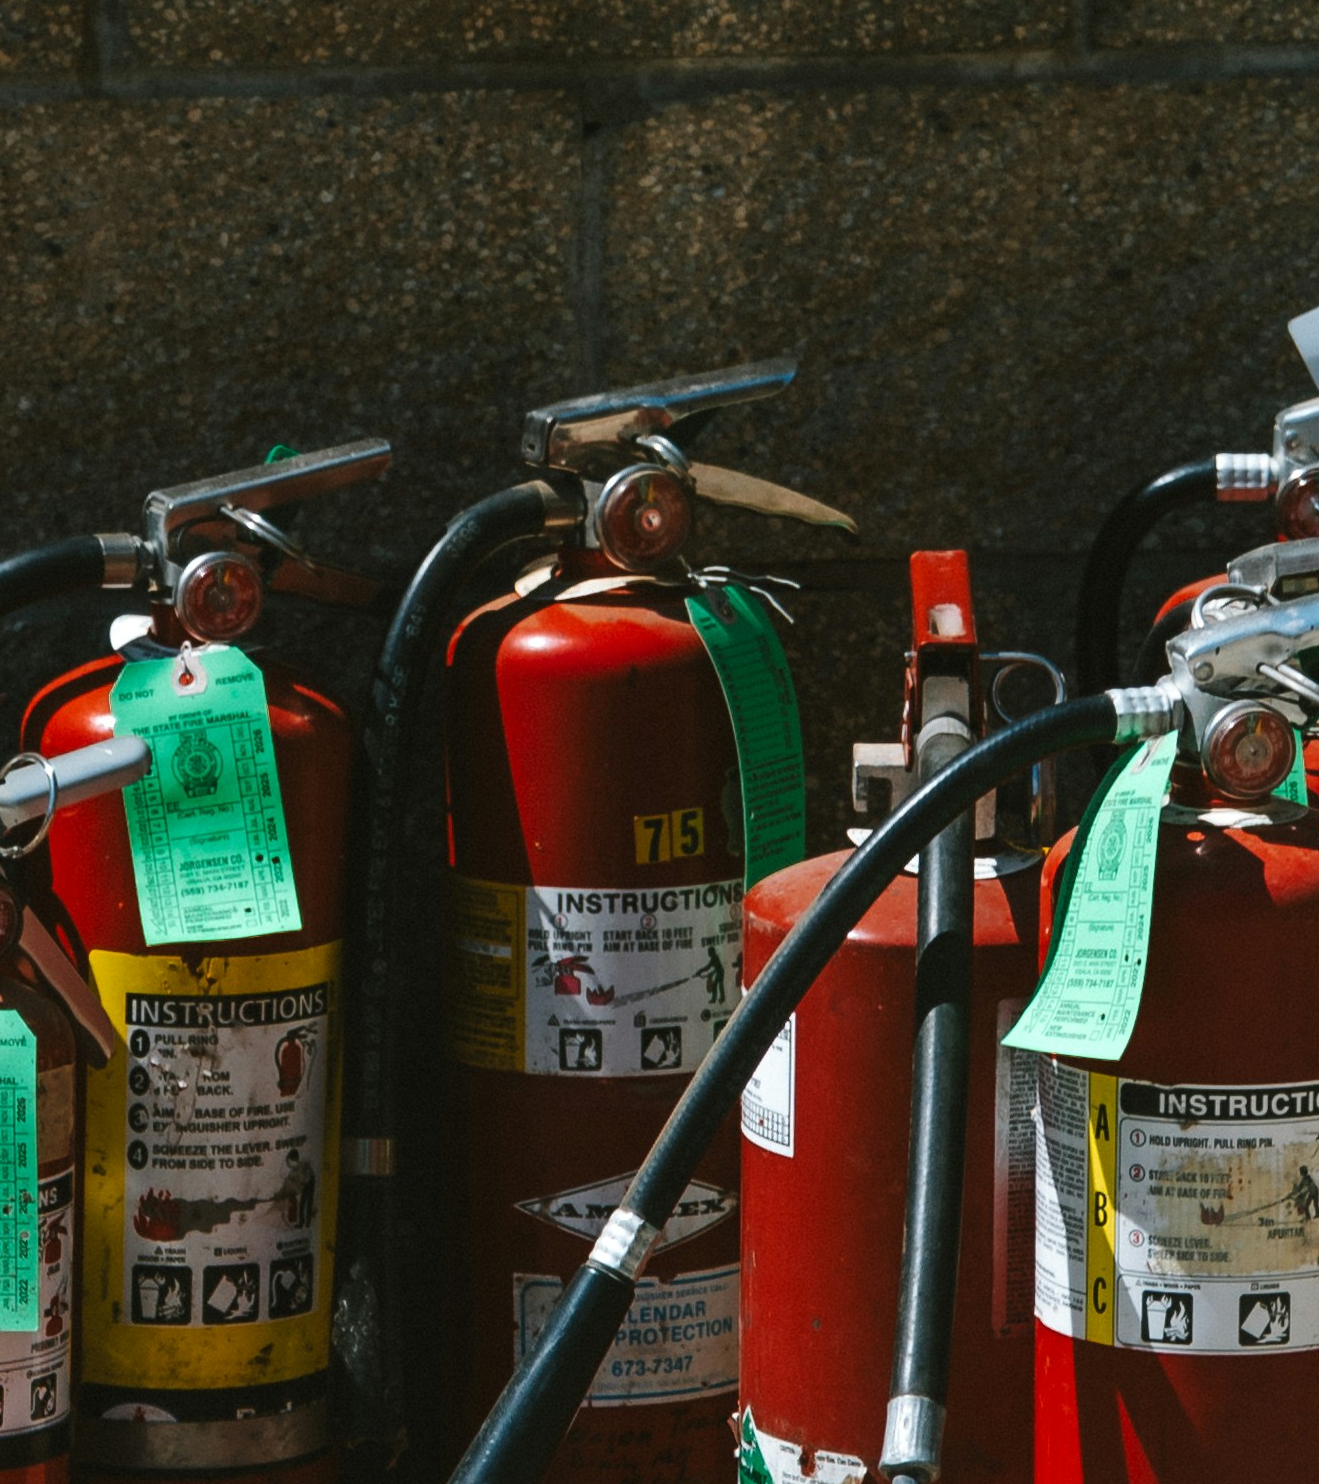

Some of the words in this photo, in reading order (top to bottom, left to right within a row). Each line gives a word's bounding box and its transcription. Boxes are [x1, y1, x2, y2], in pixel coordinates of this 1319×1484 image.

[215, 672, 255, 685] REMOVE
[119, 693, 132, 701] DO
[135, 689, 154, 699] NOT
[132, 726, 149, 736] THE
[152, 722, 181, 732] STATE
[183, 719, 204, 729] FIRE
[206, 711, 252, 724] MARSHAL
[643, 811, 700, 862] 75
[558, 882, 742, 914] INSTRUCTIONS
[603, 941, 619, 953] AIM
[623, 942, 634, 953] AT
[638, 941, 659, 952] BASE
[662, 940, 673, 952] OF
[131, 990, 324, 1024] INSTRUCTIONS
[155, 1034, 183, 1045] PULL
[188, 1034, 218, 1046] RING
[195, 1107, 226, 1118] BASE
[228, 1106, 245, 1117] OF
[1096, 1104, 1110, 1141] A
[211, 1144, 231, 1154] THE
[1149, 1135, 1171, 1147] HOLD
[1173, 1136, 1212, 1149] UPRIGHT.
[1214, 1137, 1234, 1149] PULL
[1237, 1137, 1257, 1149] RING
[153, 1157, 185, 1169] FROM
[189, 1157, 215, 1170] SIDE
[218, 1157, 234, 1169] TO
[1200, 1187, 1211, 1199] OF
[551, 1197, 729, 1219] AMEX
[1094, 1191, 1108, 1227] B
[1197, 1251, 1208, 1263] TO
[1092, 1277, 1107, 1314] C
[625, 1300, 706, 1323] LENDAR
[614, 1319, 732, 1346] PROTECTION
[611, 1355, 694, 1377] 673-7347
